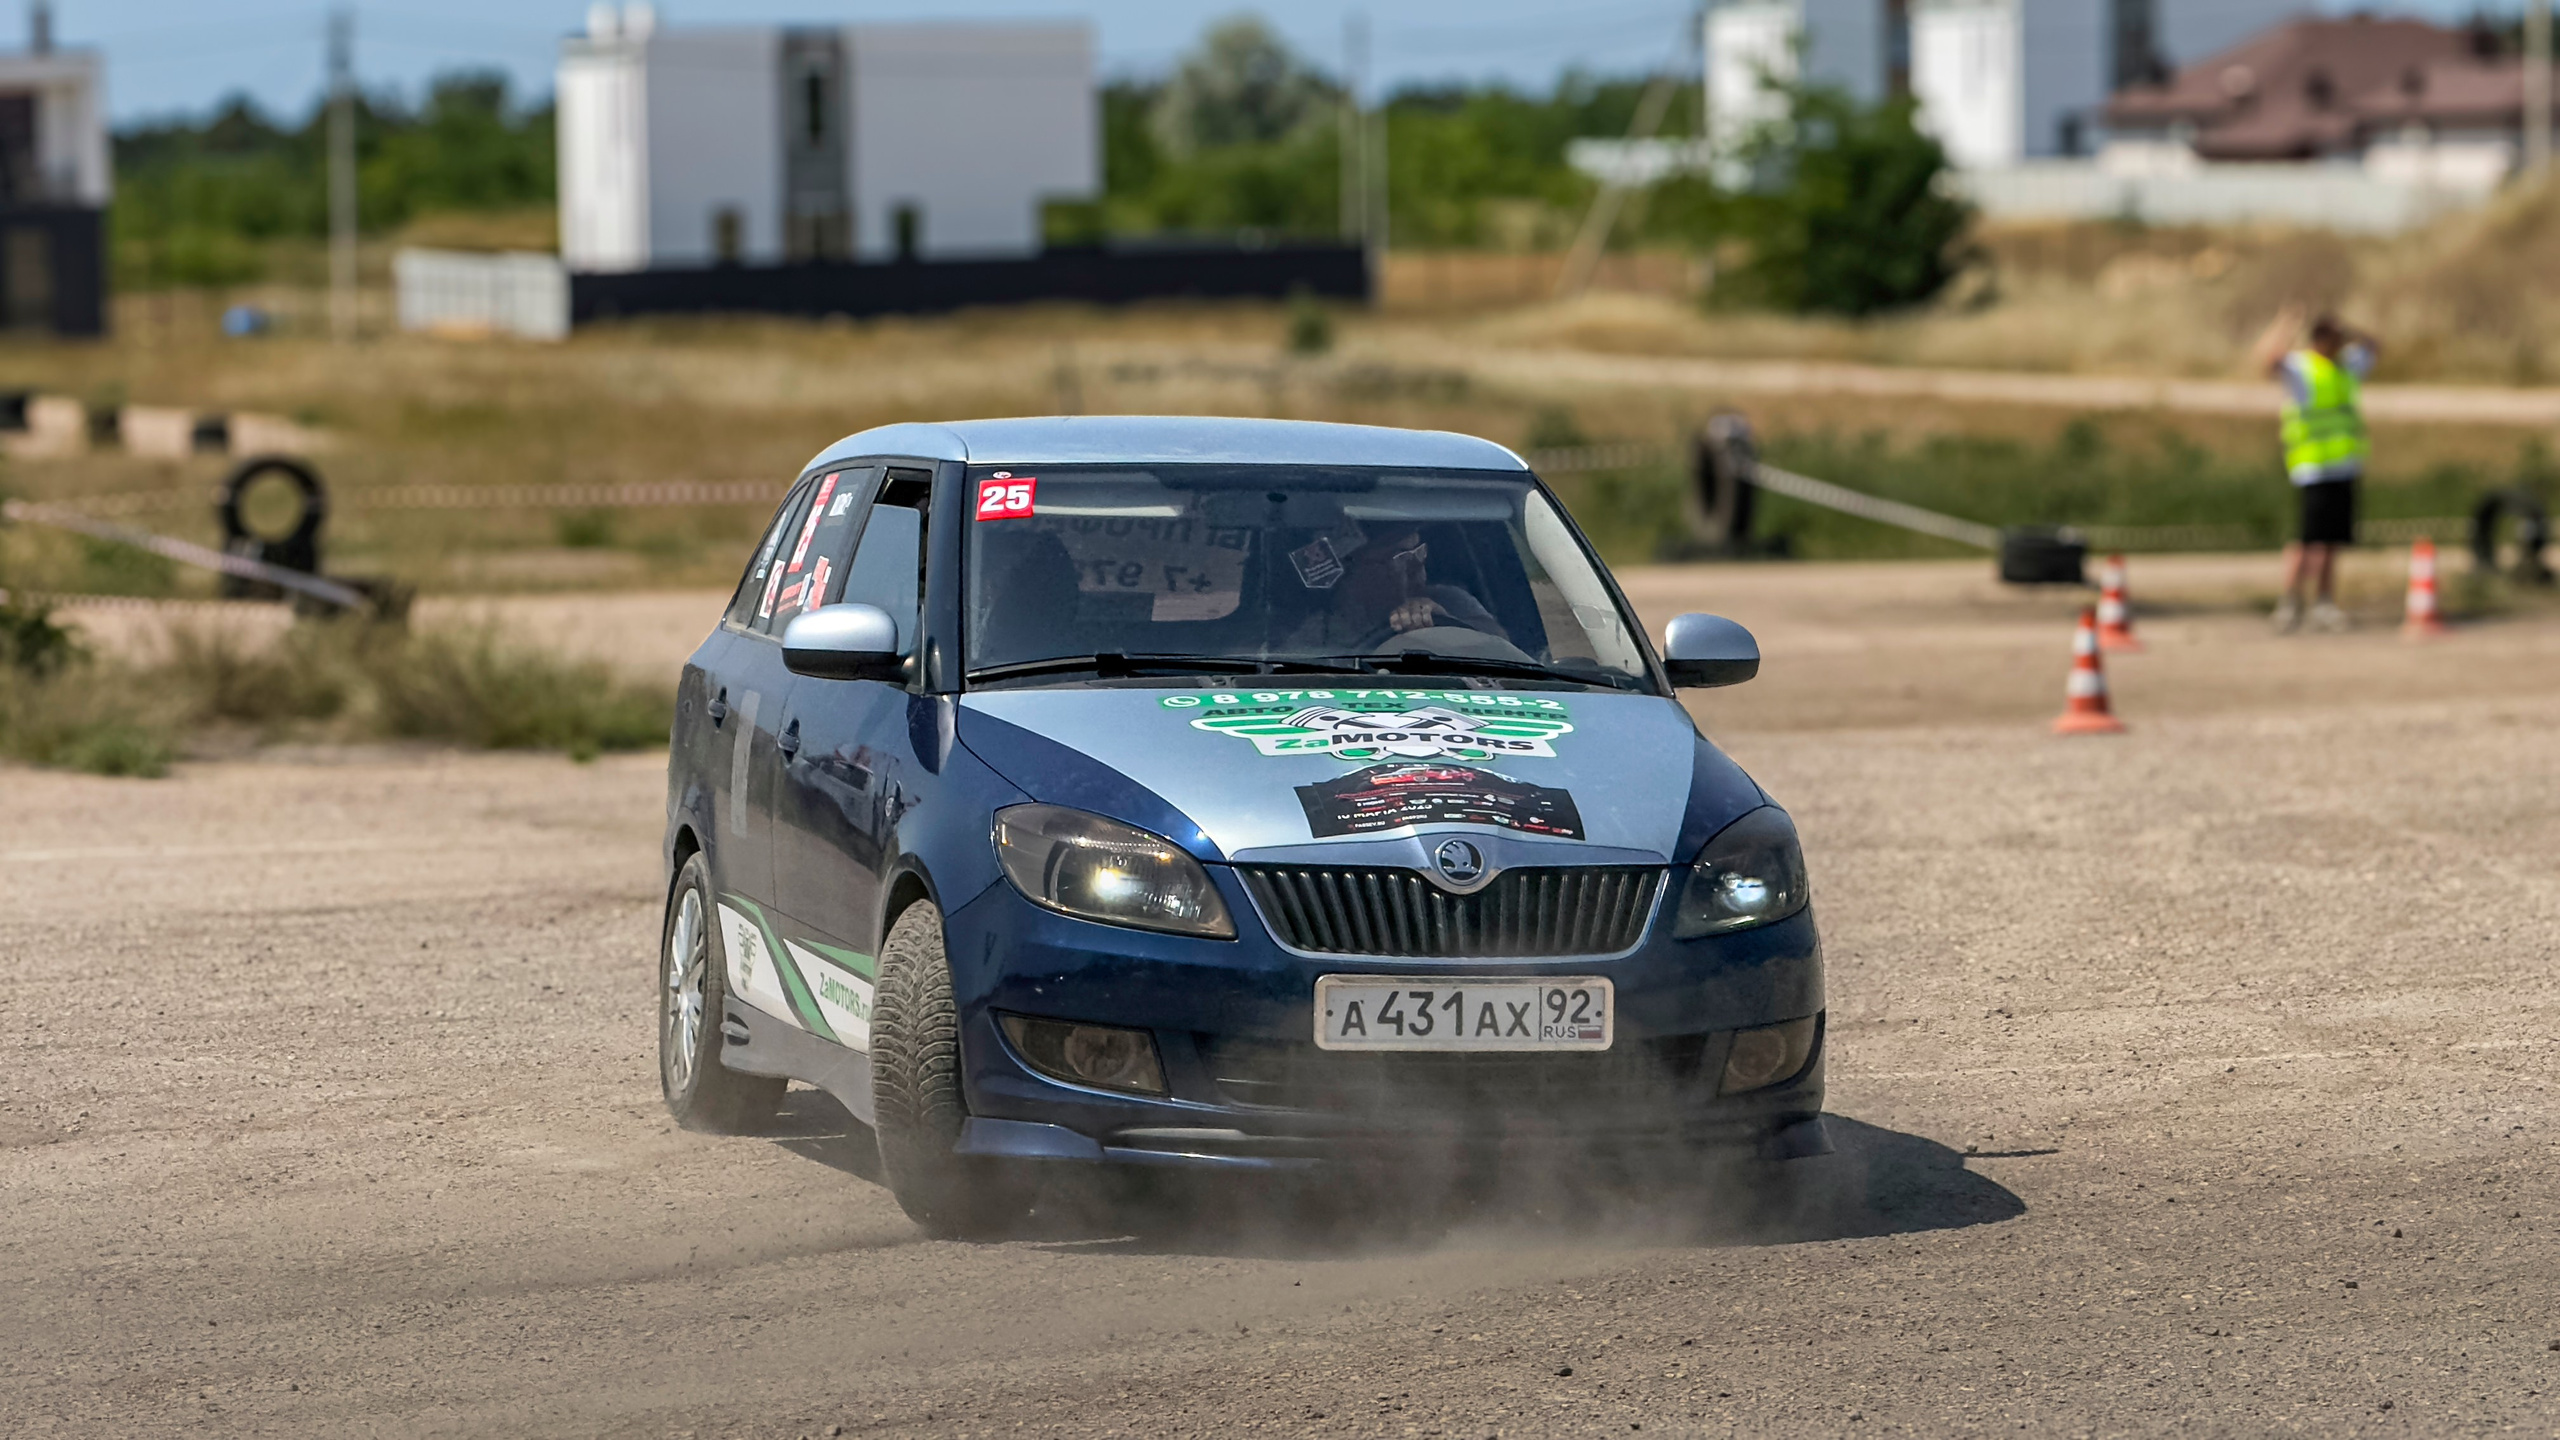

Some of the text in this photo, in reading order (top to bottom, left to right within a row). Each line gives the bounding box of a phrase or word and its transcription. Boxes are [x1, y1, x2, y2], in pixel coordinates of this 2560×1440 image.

[980, 485, 1031, 512] 25
[1211, 690, 1564, 710] 8 978 712-555-2
[1203, 705, 1294, 717] АВТО
[1274, 732, 1535, 751] ZaMOTORS
[1546, 989, 1591, 1024] 92
[1543, 1026, 1577, 1039] RUS
